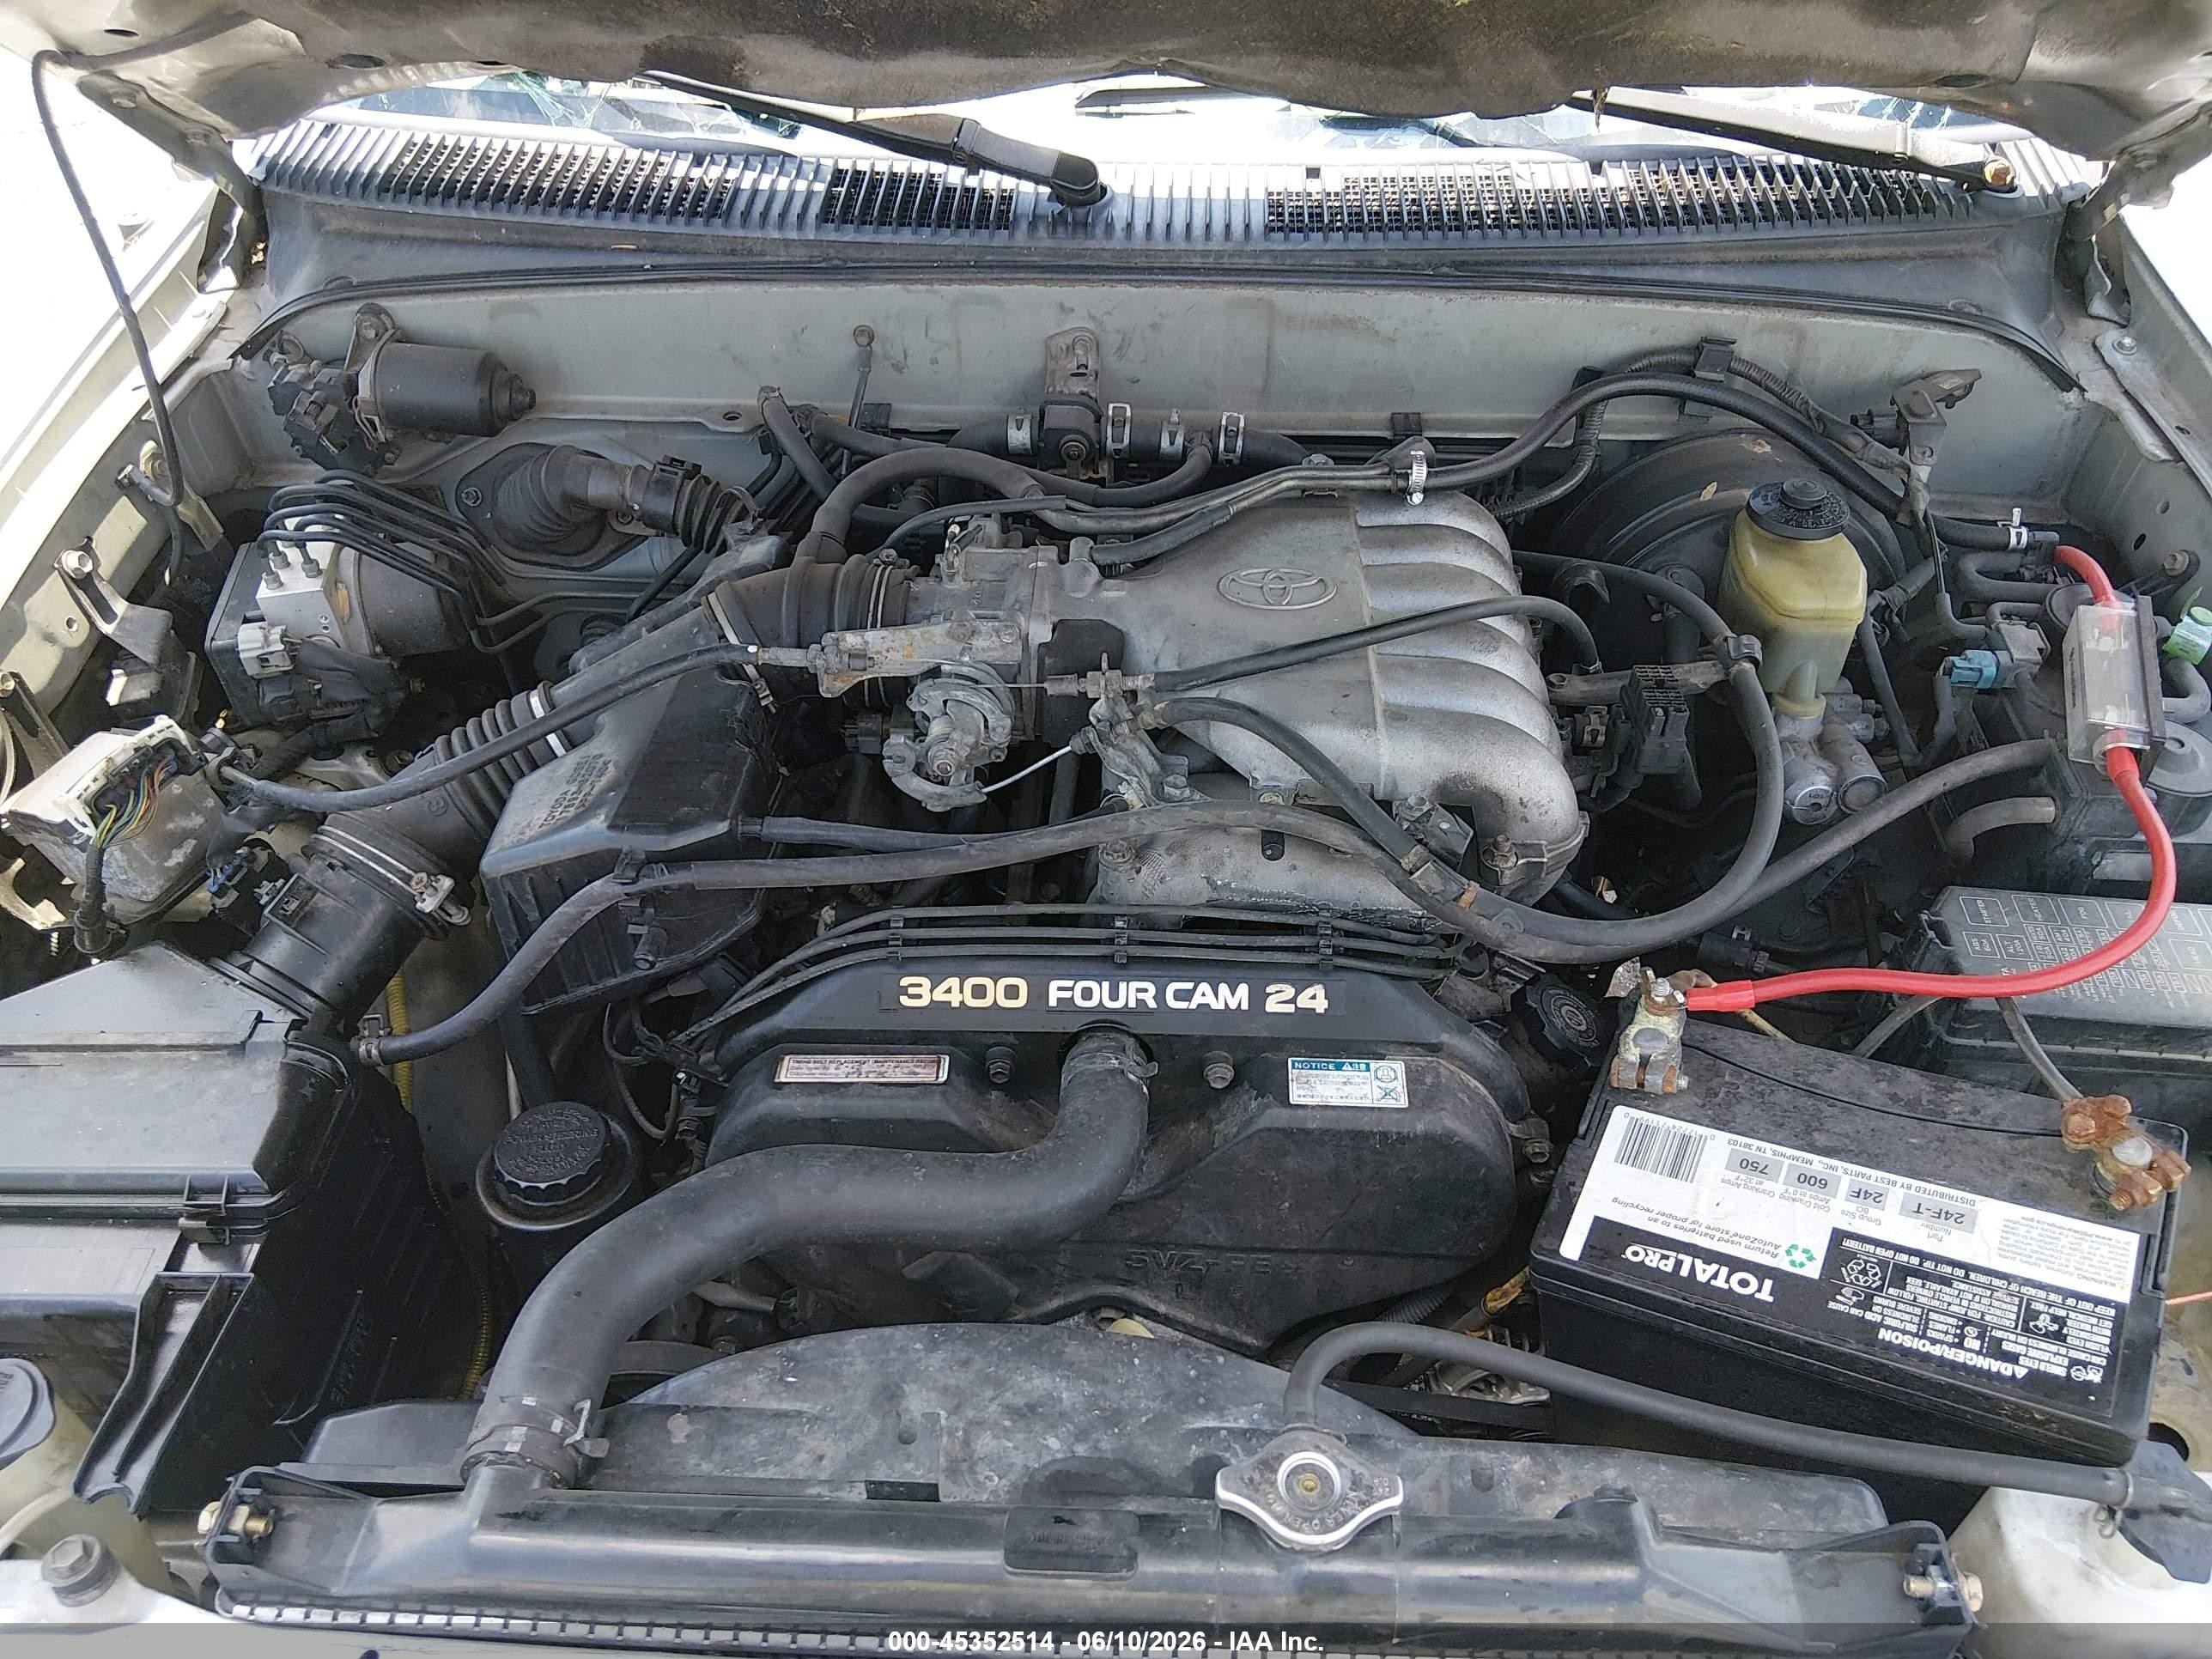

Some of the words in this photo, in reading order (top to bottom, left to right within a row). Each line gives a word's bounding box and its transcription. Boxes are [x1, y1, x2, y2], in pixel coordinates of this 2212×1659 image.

[1977, 899, 1991, 923] STARTER
[2027, 898, 2043, 921] HEATER
[1971, 938, 1981, 951] ABS
[2003, 940, 2015, 953] ALT
[899, 976, 1028, 1007] 3400
[1048, 980, 1158, 1009] FOUR
[1165, 981, 1249, 1010] CAM
[1265, 982, 1328, 1013] 24
[1726, 1138, 1753, 1150] 38103
[1768, 1148, 1813, 1165] MEMPHIS,
[1738, 1157, 1770, 1175] 750
[1839, 1165, 1872, 1180] PARTS,
[1719, 1176, 1742, 1188] Amps
[1796, 1171, 1828, 1189] 600
[1873, 1175, 1898, 1187] BEST
[1899, 1181, 1912, 1191] BY
[1741, 1182, 1775, 1198] Cranking
[1848, 1185, 1884, 1204] 24F
[1914, 1185, 1975, 1206] DISTRIBUTED
[1610, 1195, 1655, 1214] recycling
[1778, 1192, 1813, 1207] Cranking
[1808, 1192, 1831, 1204] Amps
[1812, 1202, 1830, 1212] Cold
[1839, 1208, 1856, 1219] Size
[1911, 1200, 1965, 1224] 24F-T
[1646, 1215, 1661, 1224] an
[1655, 1208, 1688, 1223] proper
[1688, 1218, 1702, 1228] for
[1857, 1213, 1882, 1225] Group
[1661, 1219, 1671, 1228] to
[1705, 1224, 1730, 1236] store
[1919, 1221, 1951, 1236] Number
[1671, 1222, 1716, 1241] batteries
[1926, 1231, 1943, 1242] Part
[1717, 1235, 1741, 1249] used
[1743, 1242, 1778, 1259] Return
[1622, 1238, 1778, 1303] TOTALPRO
[1826, 1300, 1850, 1313] CAUSE
[1849, 1306, 1864, 1317] CAN
[1863, 1310, 1882, 1322] ACID
[1882, 1315, 1918, 1333] SULFURIC
[1876, 1325, 2014, 1376] DANGER/POISON
[1962, 1335, 1981, 1351] NO
